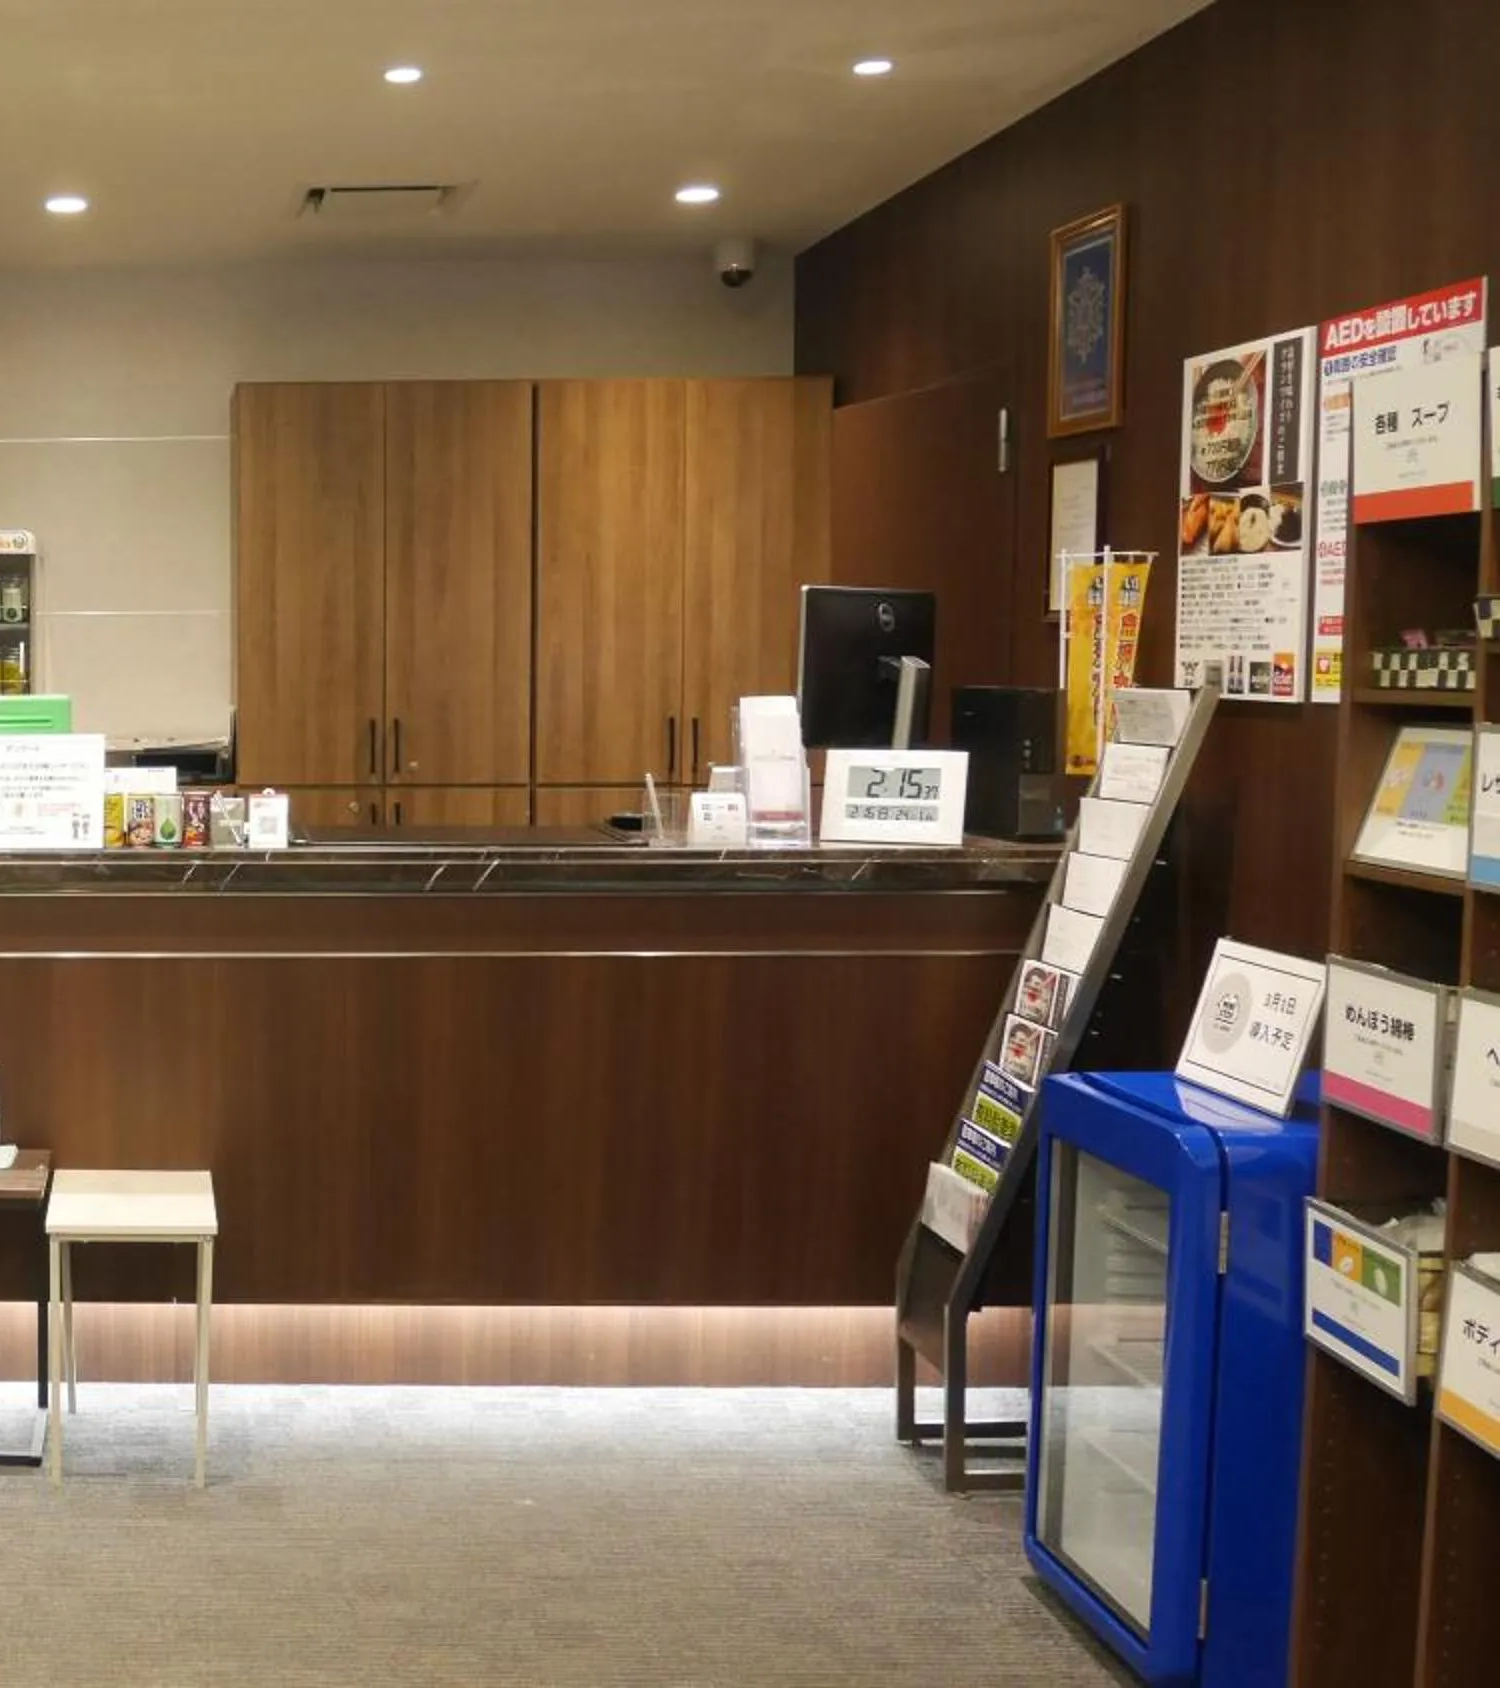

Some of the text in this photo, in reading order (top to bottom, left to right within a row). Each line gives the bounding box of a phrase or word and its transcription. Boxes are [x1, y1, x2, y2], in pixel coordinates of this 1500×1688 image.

[1324, 291, 1477, 350] AEDを設置しています
